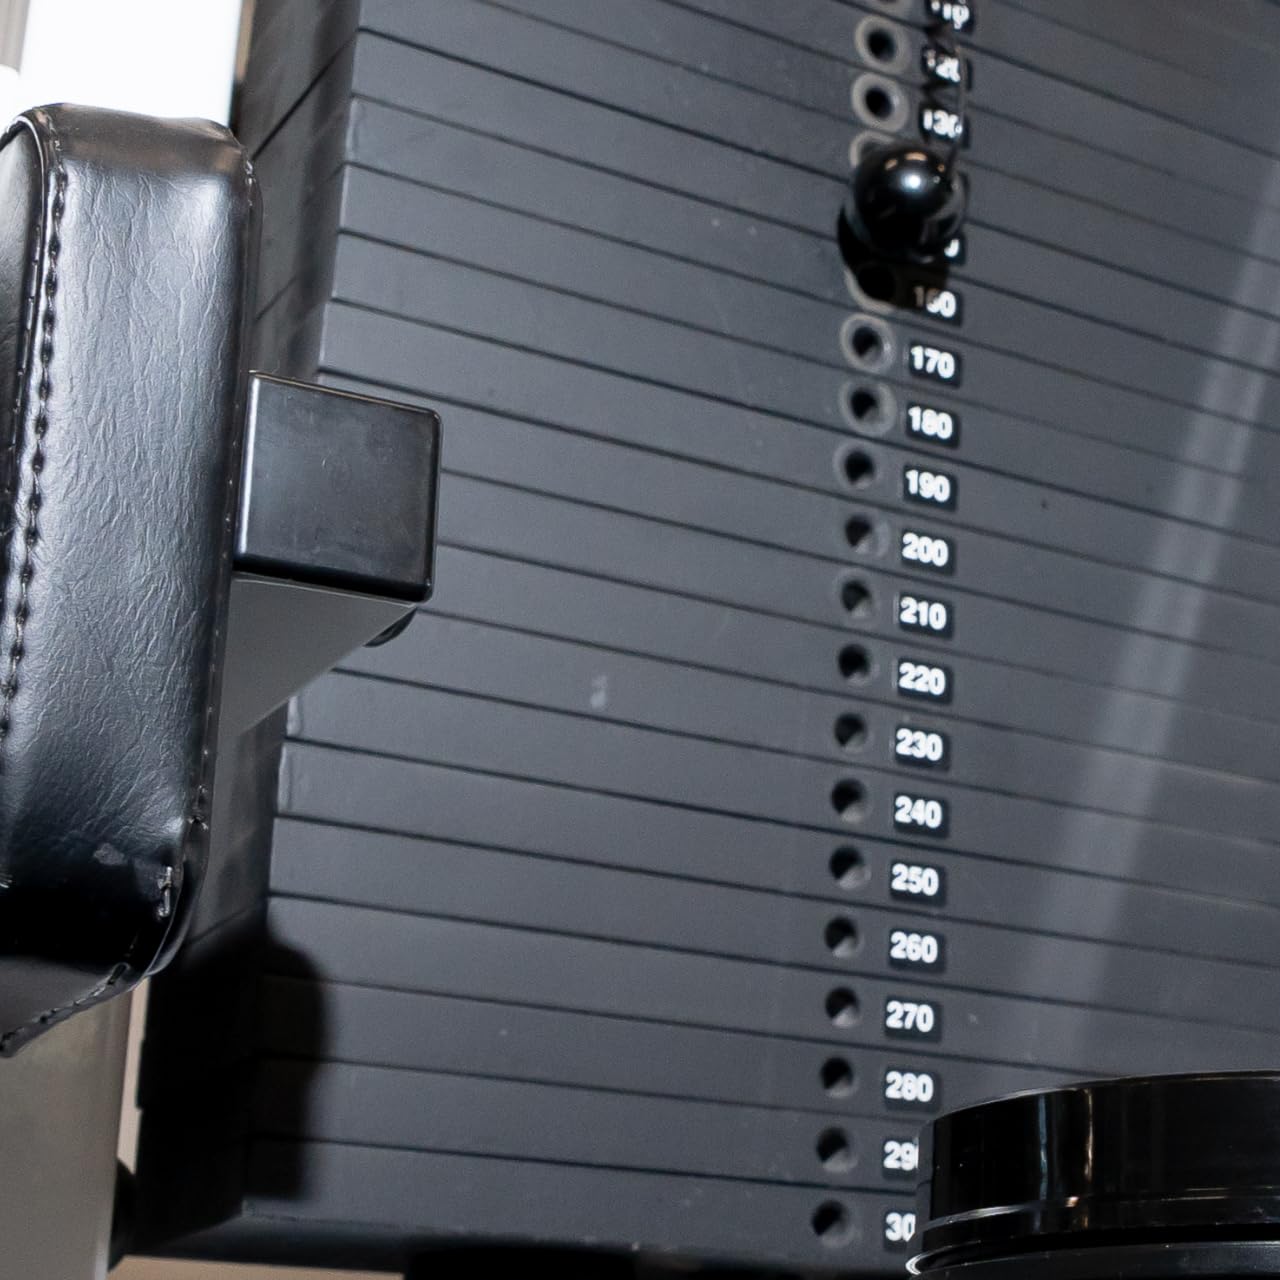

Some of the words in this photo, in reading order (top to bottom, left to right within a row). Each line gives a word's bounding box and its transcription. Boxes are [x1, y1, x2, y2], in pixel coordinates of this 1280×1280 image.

[911, 346, 954, 378] 170
[909, 407, 952, 439] 180
[906, 470, 950, 502] 190
[902, 533, 948, 566] 200
[900, 597, 946, 629] 210
[896, 663, 945, 695] 220
[896, 728, 942, 761] 230
[895, 796, 942, 828] 240
[892, 864, 938, 895] 250
[891, 932, 938, 963] 260
[886, 1001, 934, 1032] 270
[886, 1071, 933, 1102] 280
[883, 1140, 919, 1172] 29
